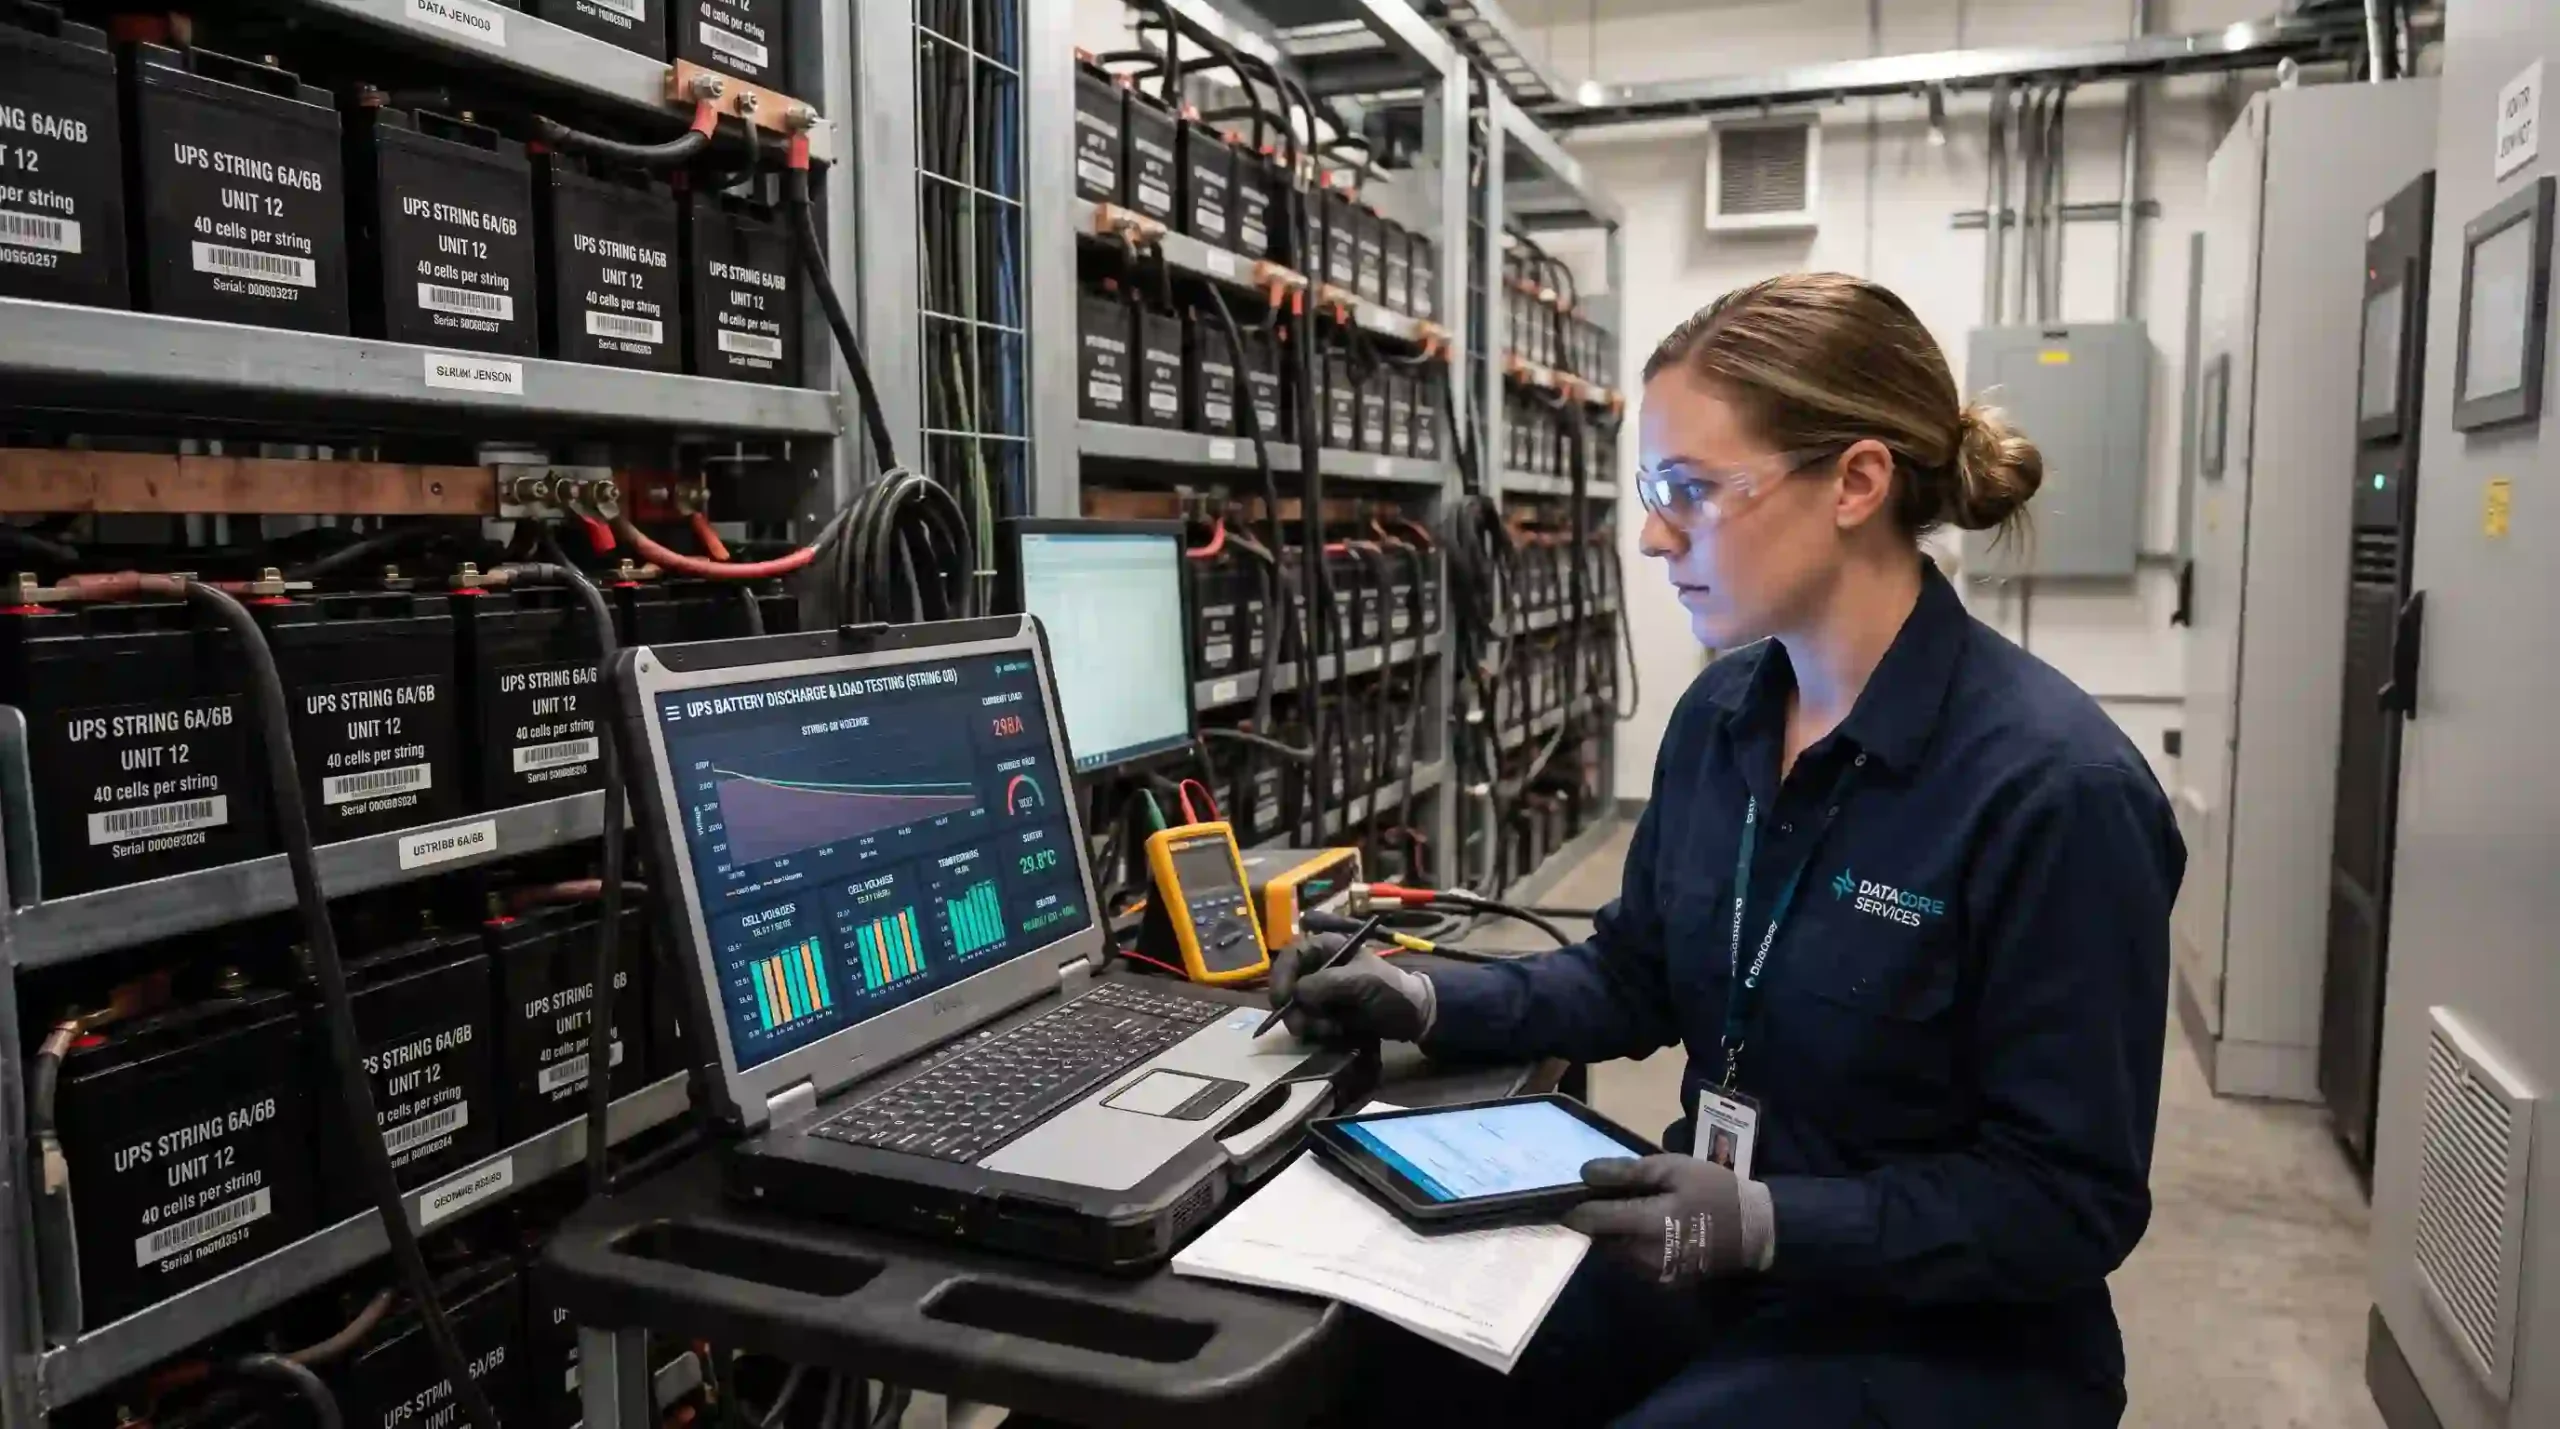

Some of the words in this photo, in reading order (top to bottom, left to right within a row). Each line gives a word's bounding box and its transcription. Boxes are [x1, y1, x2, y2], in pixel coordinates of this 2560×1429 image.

[31, 112, 88, 144] 6A/6B
[15, 148, 39, 173] 12
[174, 142, 209, 169] UPS
[214, 152, 273, 183] STRING
[277, 164, 323, 192] 6A/6B
[28, 190, 74, 215] string
[221, 187, 259, 213] UNIT
[265, 196, 284, 218] 12
[403, 196, 430, 219] UPS
[433, 204, 479, 229] STRING
[482, 213, 517, 236] 6A/6B
[194, 216, 212, 234] 40
[215, 222, 247, 241] cells
[250, 227, 271, 247] per
[275, 232, 311, 254] string
[438, 235, 468, 256] UNIT
[471, 242, 487, 260] 12
[574, 233, 596, 254] UPS
[599, 239, 637, 263] STRING
[417, 260, 431, 276] 40
[434, 264, 459, 280] cells
[461, 269, 477, 286] per
[480, 273, 510, 291] string
[602, 267, 628, 287] UNIT
[630, 274, 643, 290] 12
[709, 260, 728, 279] UPS
[586, 290, 598, 305] 40
[754, 295, 764, 311] 12
[473, 369, 512, 383] JENSON
[501, 675, 525, 693] UPS
[528, 670, 570, 690] STRING
[572, 667, 597, 686] 6A/6
[687, 701, 713, 718] UPS
[714, 693, 765, 715] BATTERY
[766, 685, 828, 707] DISCHARGE
[837, 680, 864, 697] LOAD
[864, 673, 905, 693] TESTING
[906, 669, 941, 692] (STRING
[307, 694, 336, 714] UPS
[341, 688, 393, 711] STRING
[396, 684, 435, 704] 6A/6B
[532, 697, 556, 716] UNIT
[563, 695, 577, 711] 12
[68, 718, 107, 742] UPS
[112, 710, 179, 737] STRING
[184, 706, 233, 730] 6A/6B
[348, 720, 380, 741] UNIT
[384, 717, 401, 736] 12
[516, 726, 528, 740] 40
[120, 746, 163, 771] UNIT
[168, 743, 189, 764] 12
[326, 752, 342, 768] 40
[344, 749, 372, 767] cells
[374, 748, 391, 766] per
[394, 743, 425, 761] string
[94, 786, 112, 803] 40
[116, 781, 149, 800] cells
[154, 779, 176, 799] per
[180, 774, 218, 792] string
[112, 843, 145, 858] Serial
[1854, 896, 1921, 928] SERVICES
[1858, 880, 1945, 915] DATACORE
[525, 997, 550, 1019] UPS
[553, 983, 593, 1010] STRING
[556, 1012, 583, 1035] UNIT
[586, 1008, 592, 1024] 1
[383, 1037, 432, 1070] STRING
[389, 1070, 421, 1096] UNIT
[425, 1063, 441, 1085] 12
[377, 1110, 385, 1125] 0
[387, 1099, 412, 1123] cells
[414, 1093, 431, 1113] per
[433, 1085, 461, 1107] string
[114, 1141, 151, 1172] UPS
[158, 1117, 223, 1157] STRING
[228, 1098, 276, 1131] 6A/6B
[168, 1155, 209, 1187] UNIT
[214, 1145, 235, 1170] 12
[142, 1207, 159, 1225] 40
[163, 1194, 195, 1219] cells
[199, 1184, 221, 1207] per
[224, 1169, 262, 1193] string
[384, 1401, 412, 1429] UPS
[416, 1379, 452, 1412] STRIN
